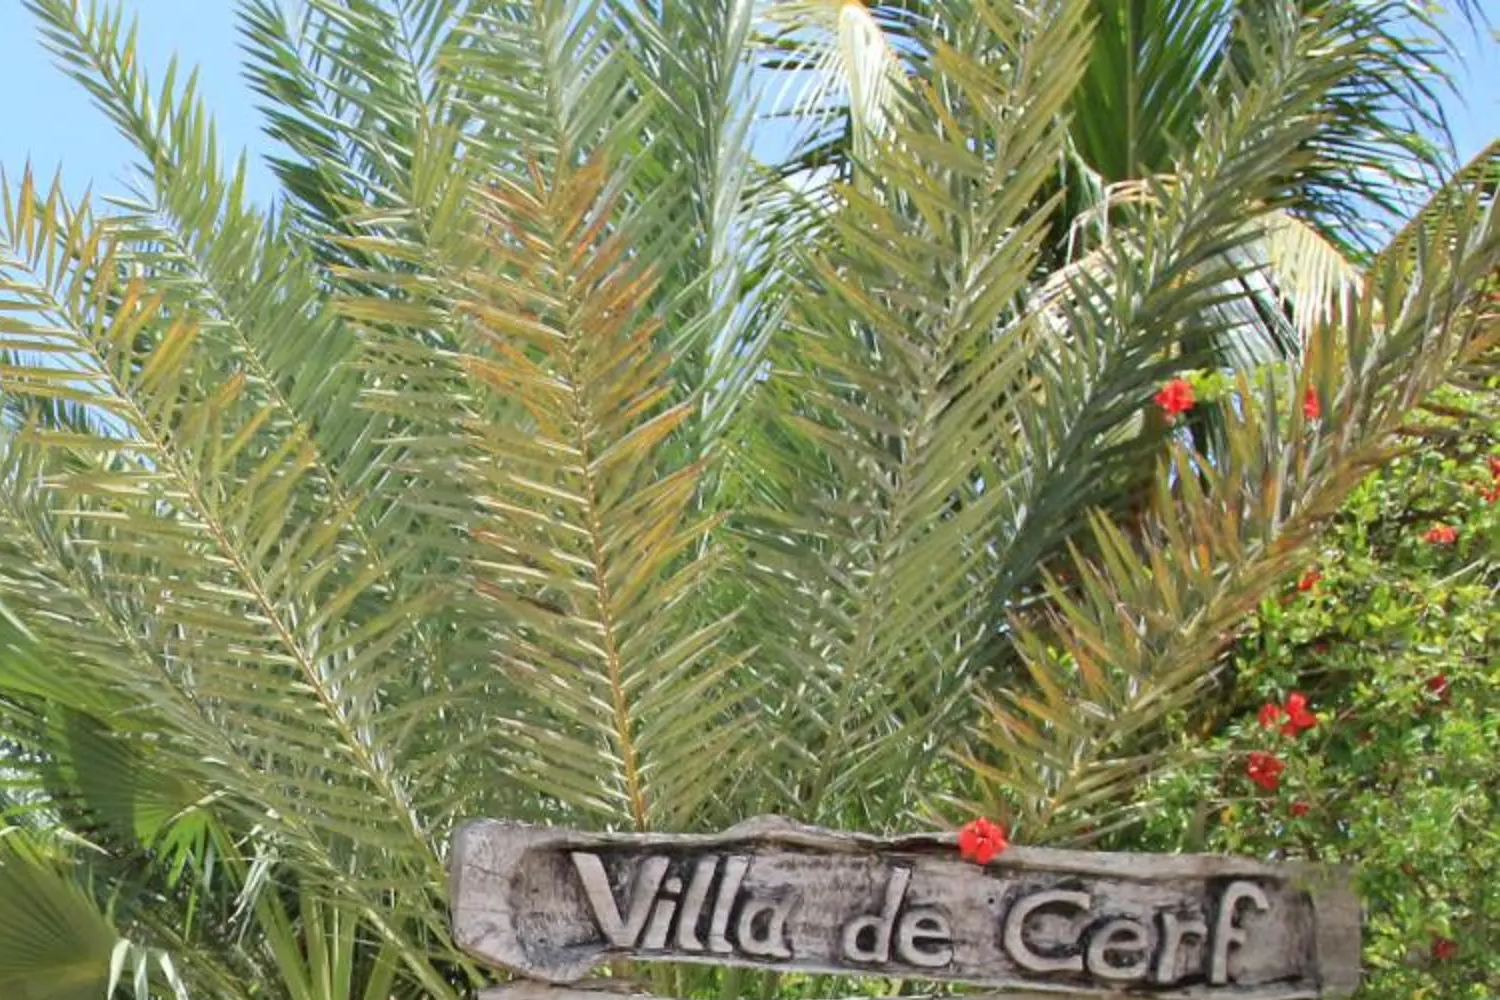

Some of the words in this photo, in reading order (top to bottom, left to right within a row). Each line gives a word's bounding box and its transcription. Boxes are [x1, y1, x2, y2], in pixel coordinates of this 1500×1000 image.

[571, 851, 794, 959] Villa
[842, 866, 954, 968] de
[1004, 879, 1270, 985] Cerf
